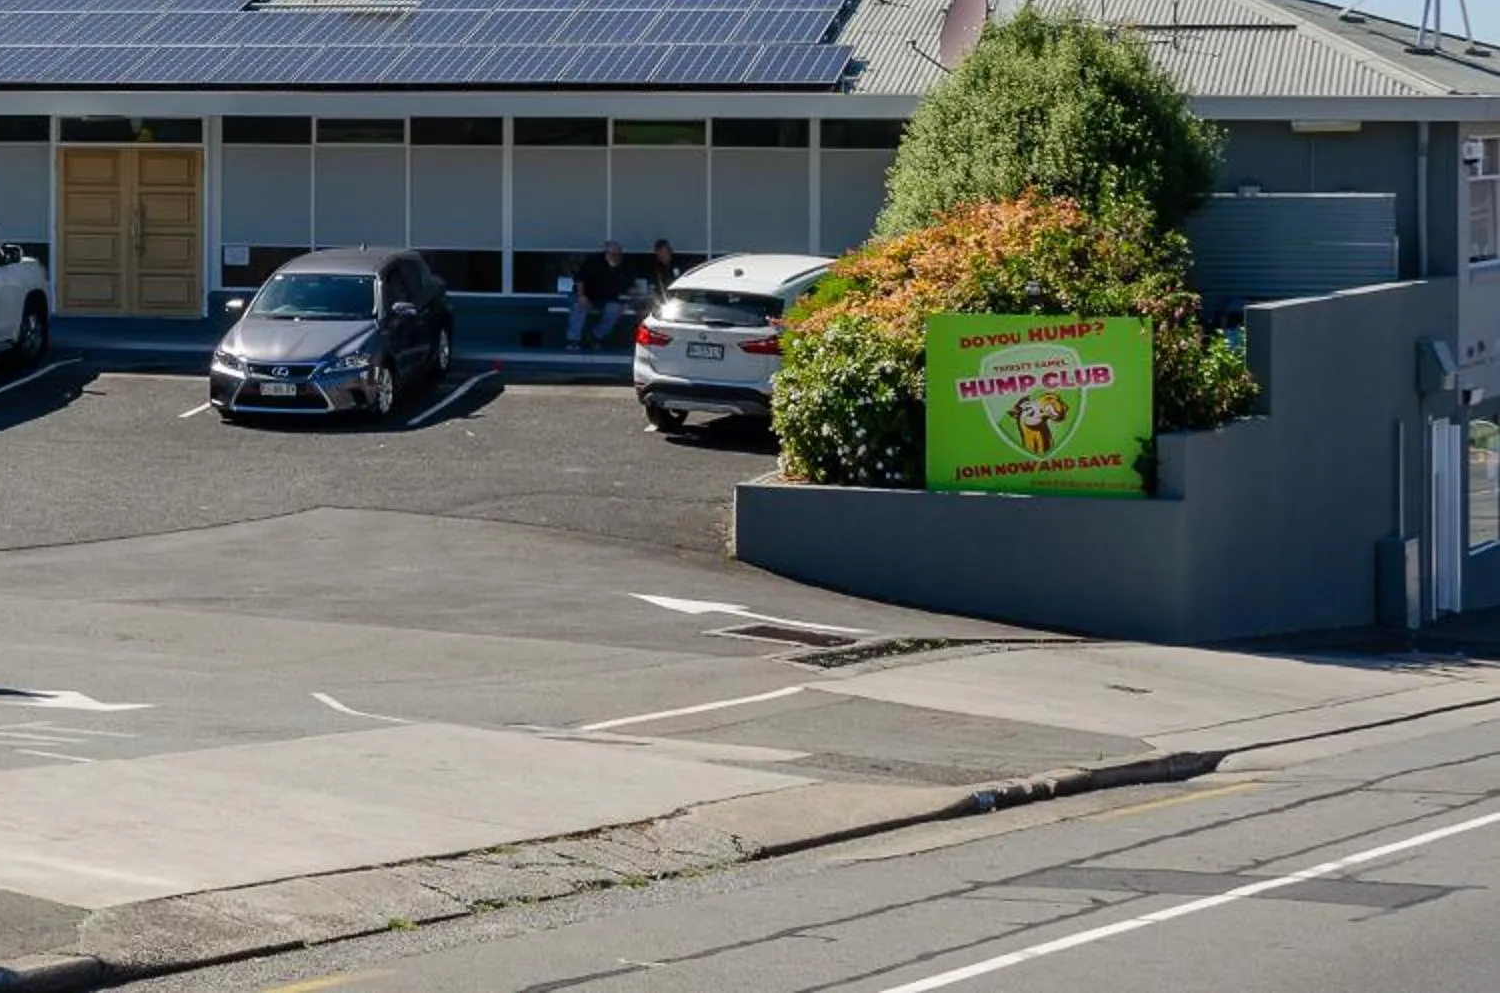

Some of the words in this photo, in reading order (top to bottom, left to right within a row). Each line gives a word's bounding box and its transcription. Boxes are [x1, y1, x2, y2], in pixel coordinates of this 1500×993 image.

[959, 336, 984, 349] DO
[984, 332, 1021, 346] YOU
[1027, 320, 1105, 343] HUMP?
[959, 374, 1037, 398] HUMP
[1041, 366, 1112, 389] CLUB
[956, 466, 992, 482] JOIN
[995, 460, 1037, 475] NOW
[1036, 457, 1079, 472] AND
[1078, 454, 1123, 469] SAVE
